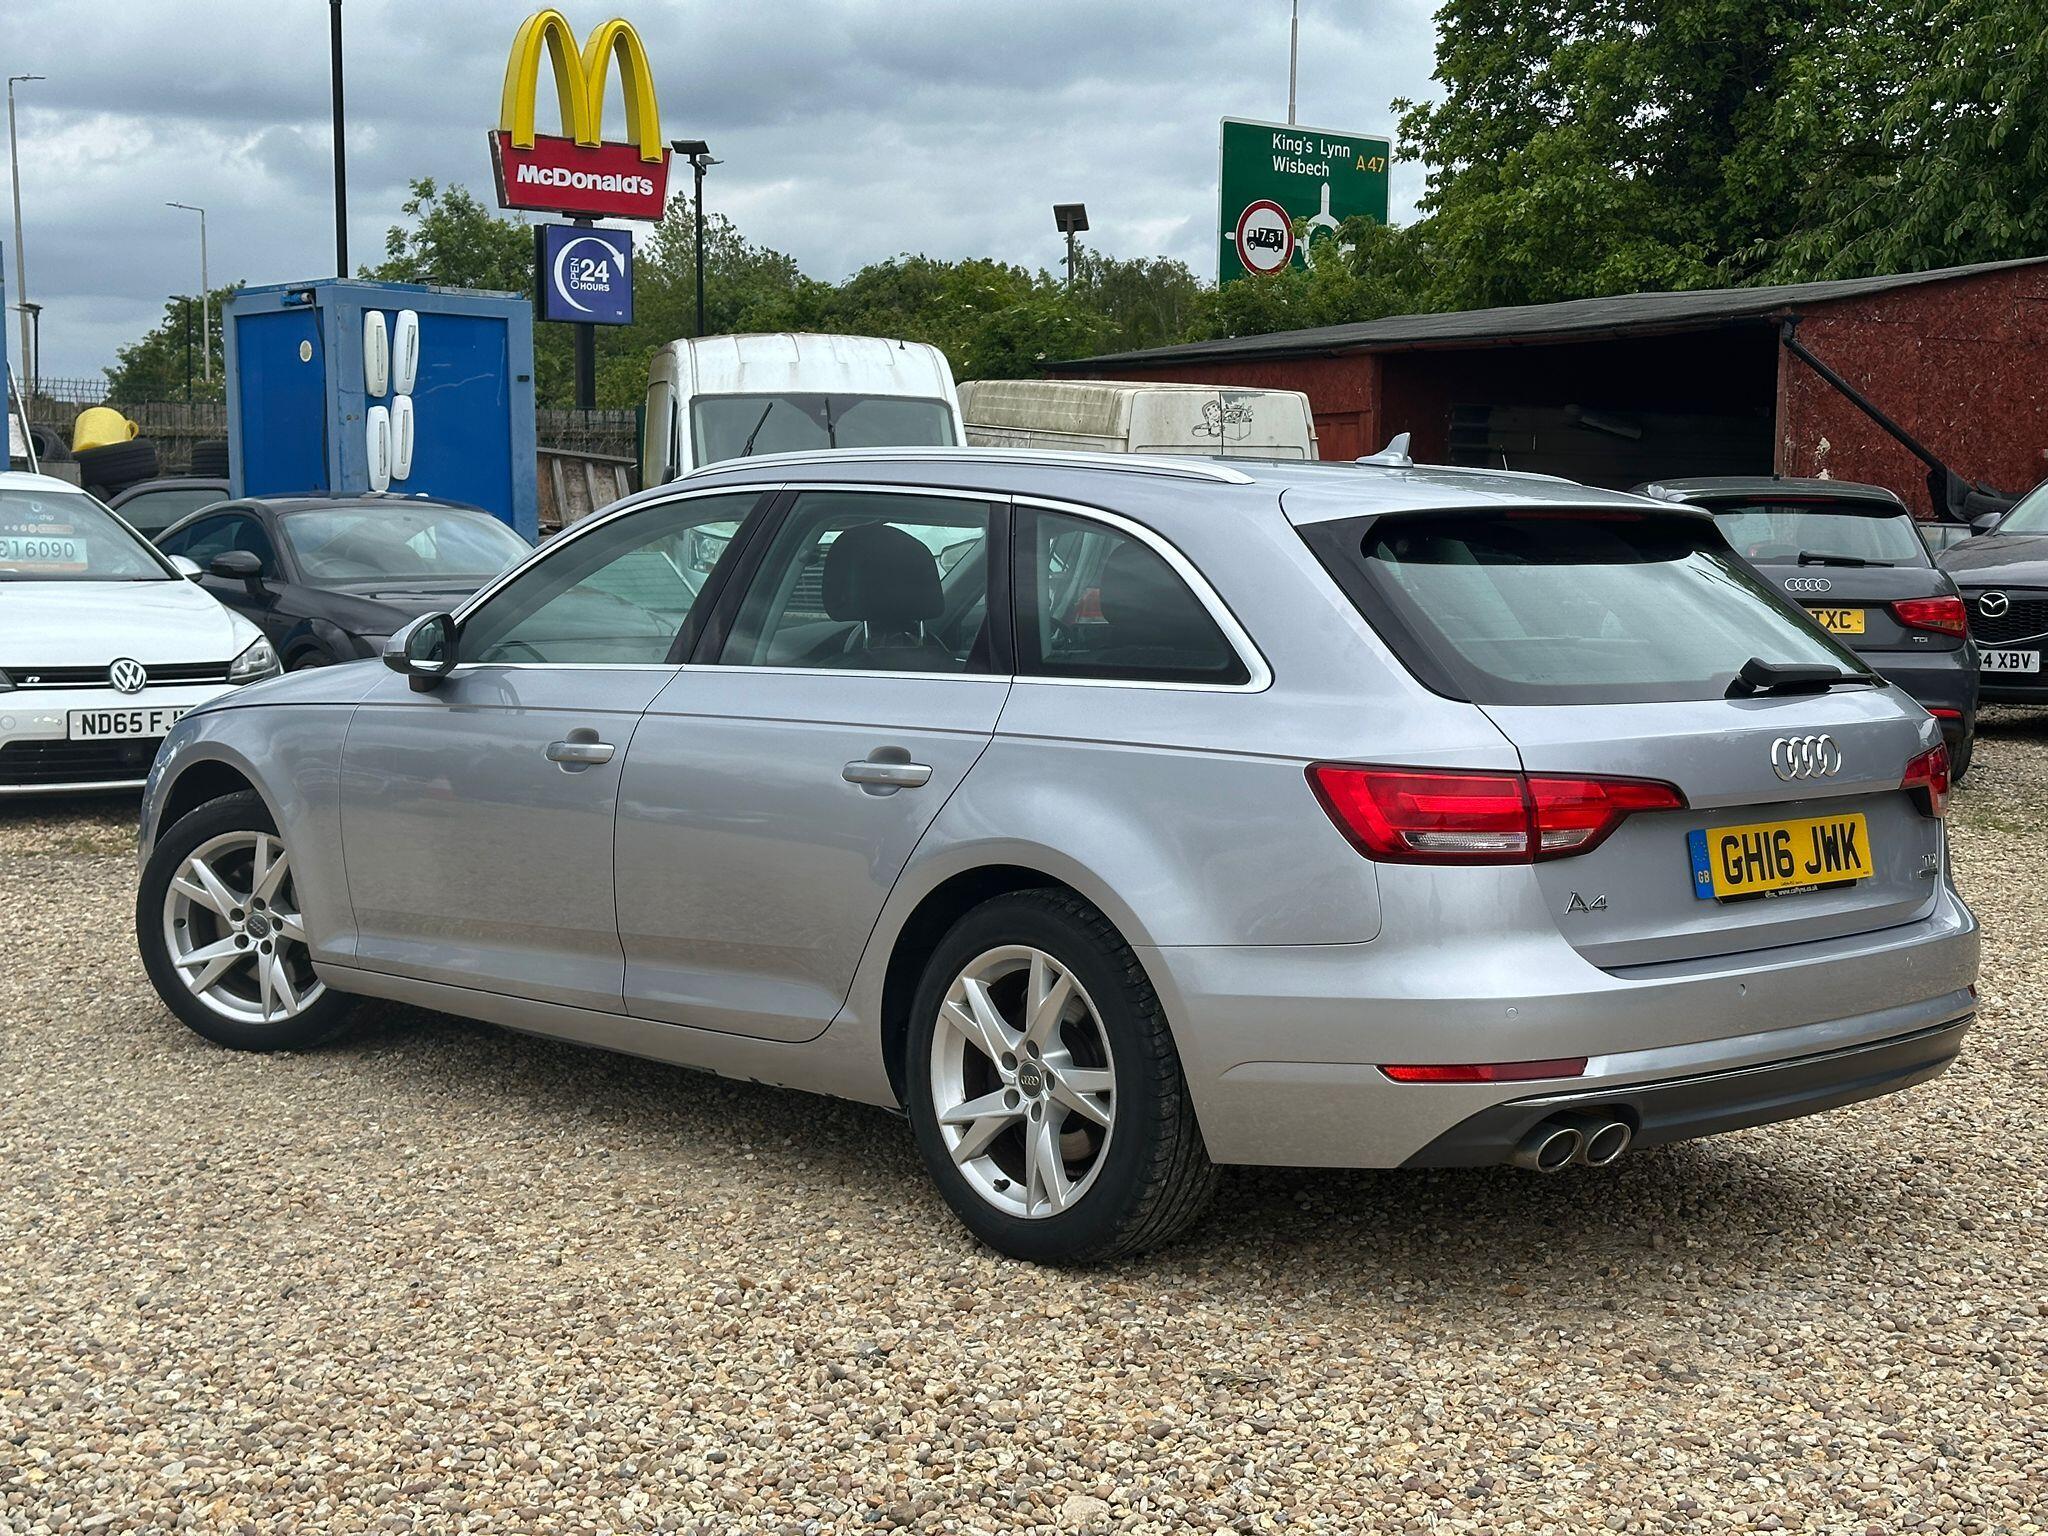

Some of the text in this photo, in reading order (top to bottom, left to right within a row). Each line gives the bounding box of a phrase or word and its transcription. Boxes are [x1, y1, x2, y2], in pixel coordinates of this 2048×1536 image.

[1272, 133, 1350, 159] King's Lynn
[1273, 155, 1330, 177] Wisbech
[517, 164, 654, 196] McDonald's
[570, 257, 580, 290] OPEN
[580, 258, 610, 283] 24
[580, 282, 610, 292] HOURS
[1811, 610, 1851, 628] TXC
[1978, 652, 2031, 669] 4 XBV
[82, 710, 184, 735] ND65 FJ
[1720, 822, 1862, 885] GH16 JWK
[1698, 870, 1710, 884] GB
[1563, 890, 1608, 915] A4
